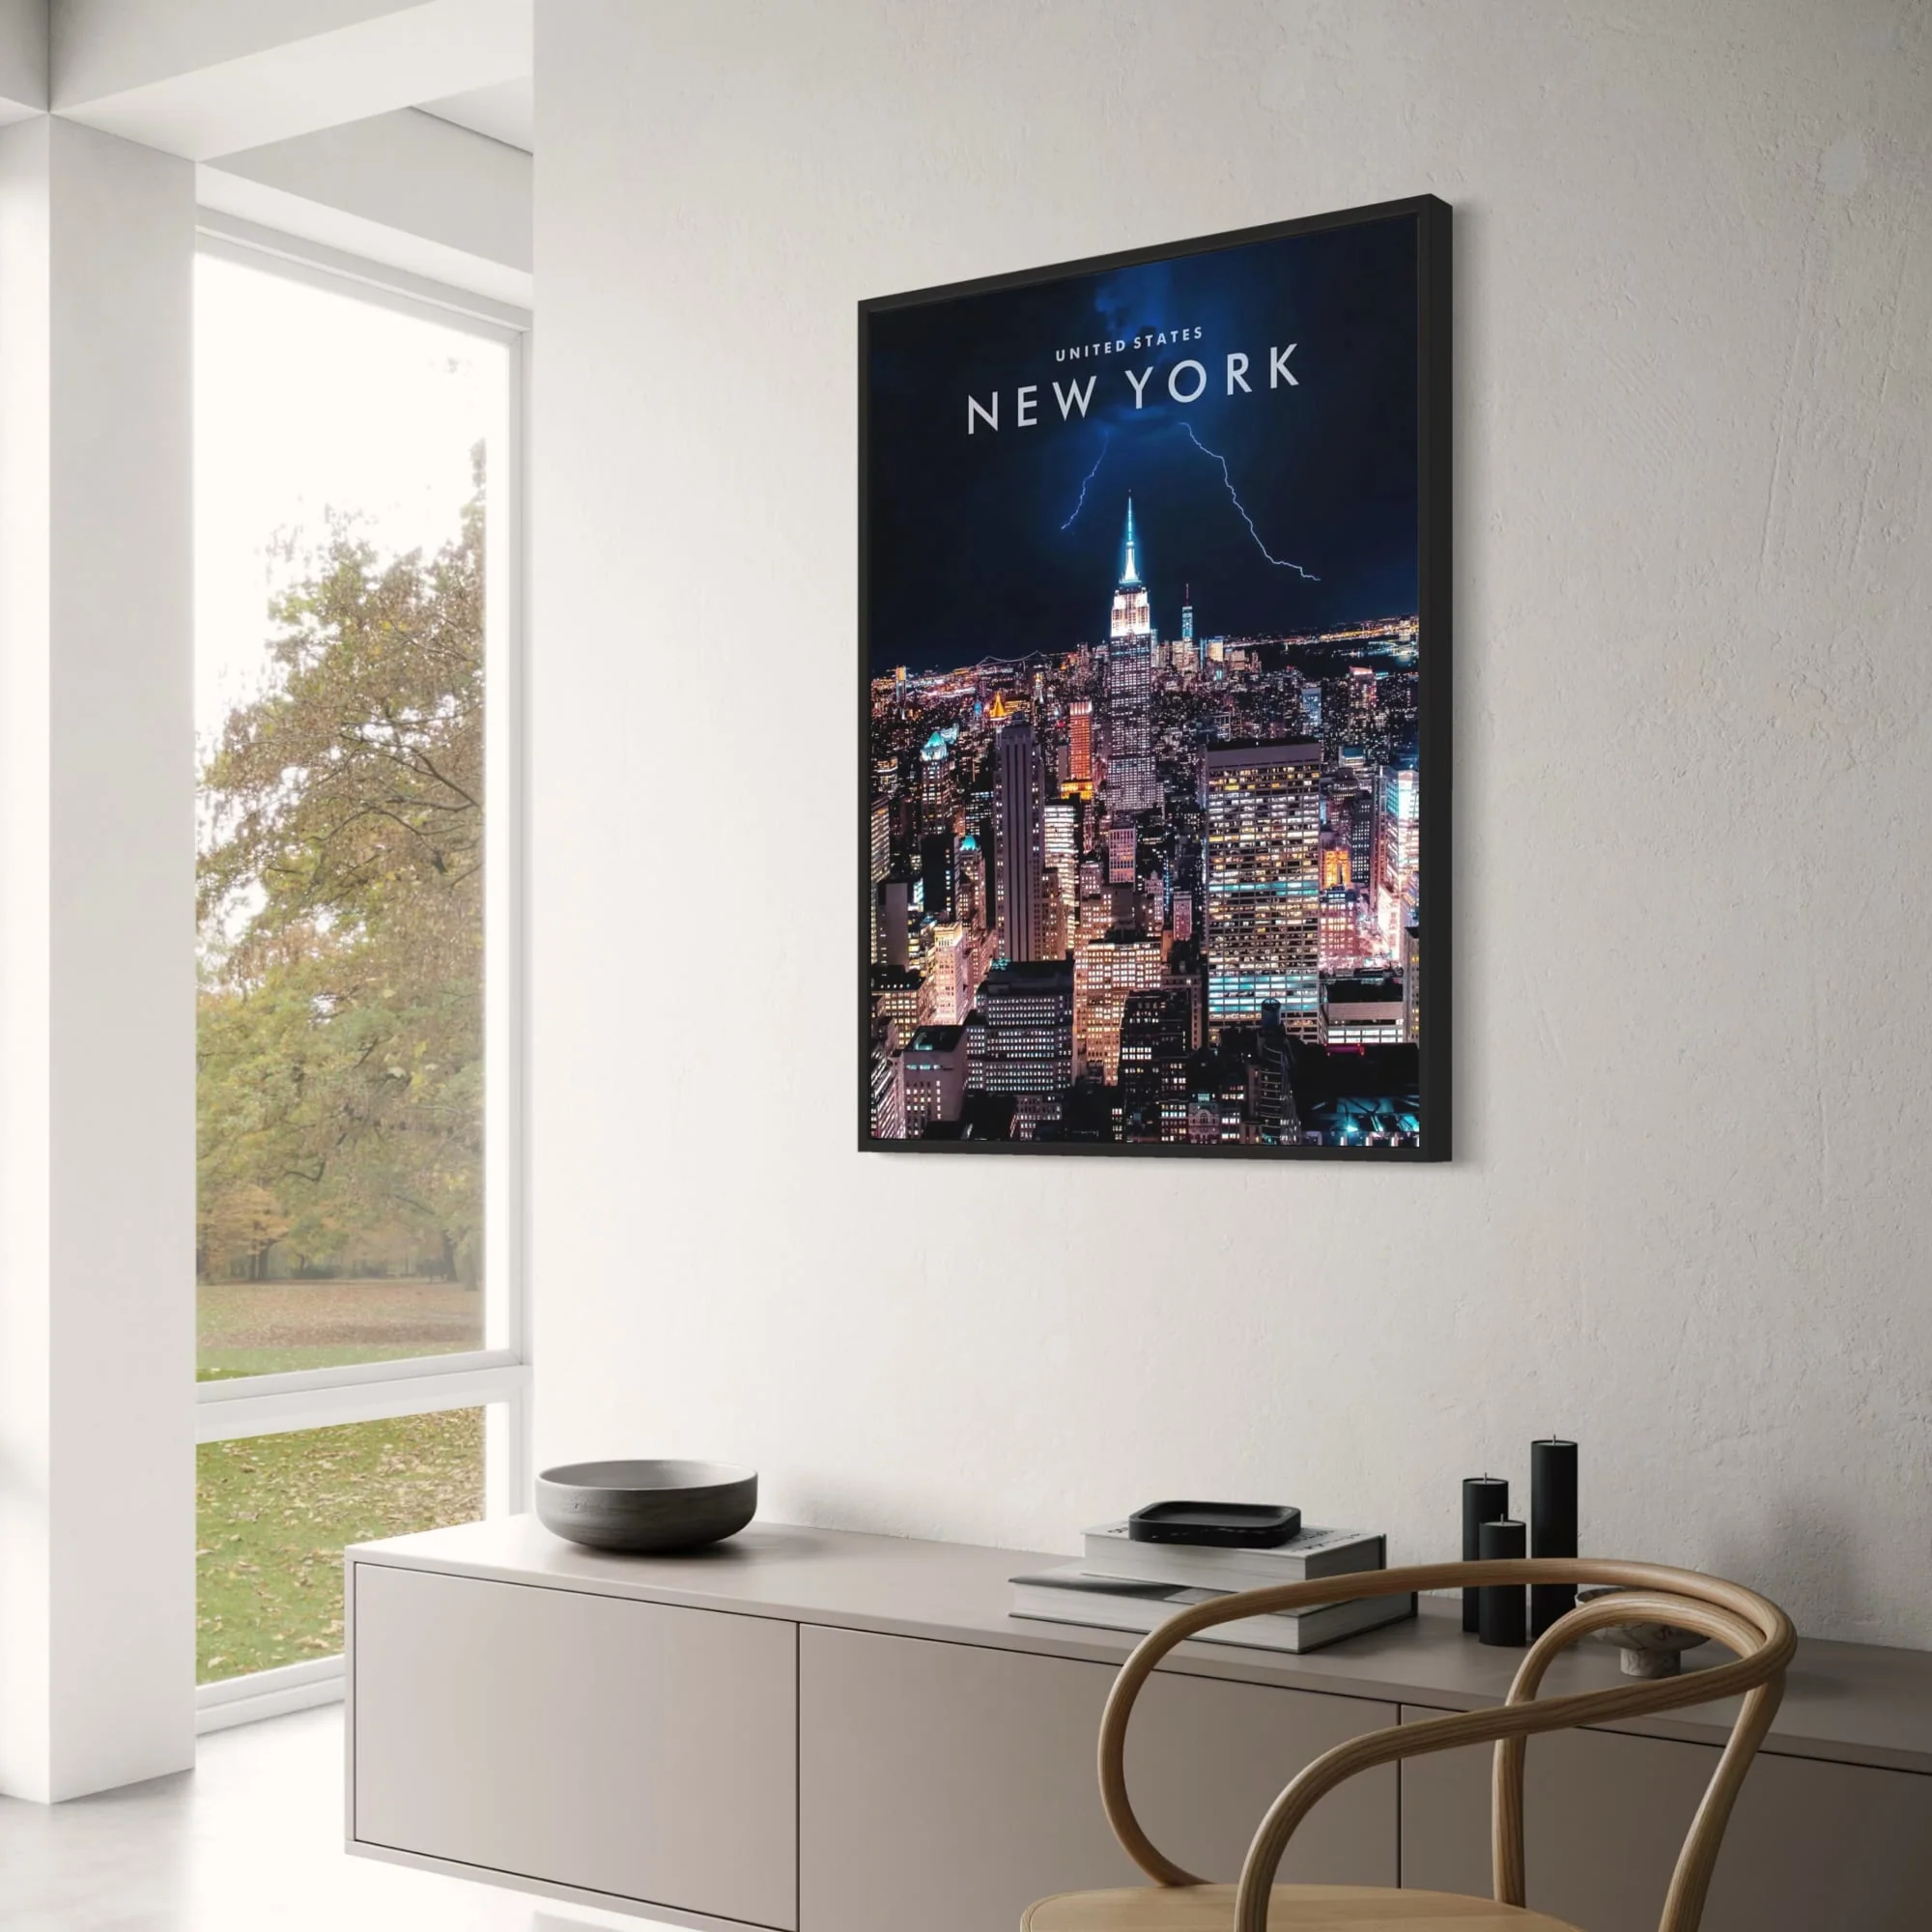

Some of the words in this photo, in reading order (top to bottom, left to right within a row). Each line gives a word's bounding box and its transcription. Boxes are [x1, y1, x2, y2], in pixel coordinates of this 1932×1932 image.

[1055, 338, 1125, 362] UNITED
[1133, 327, 1203, 350] STATES
[968, 375, 1097, 435] NEW
[1124, 343, 1299, 410] YORK
